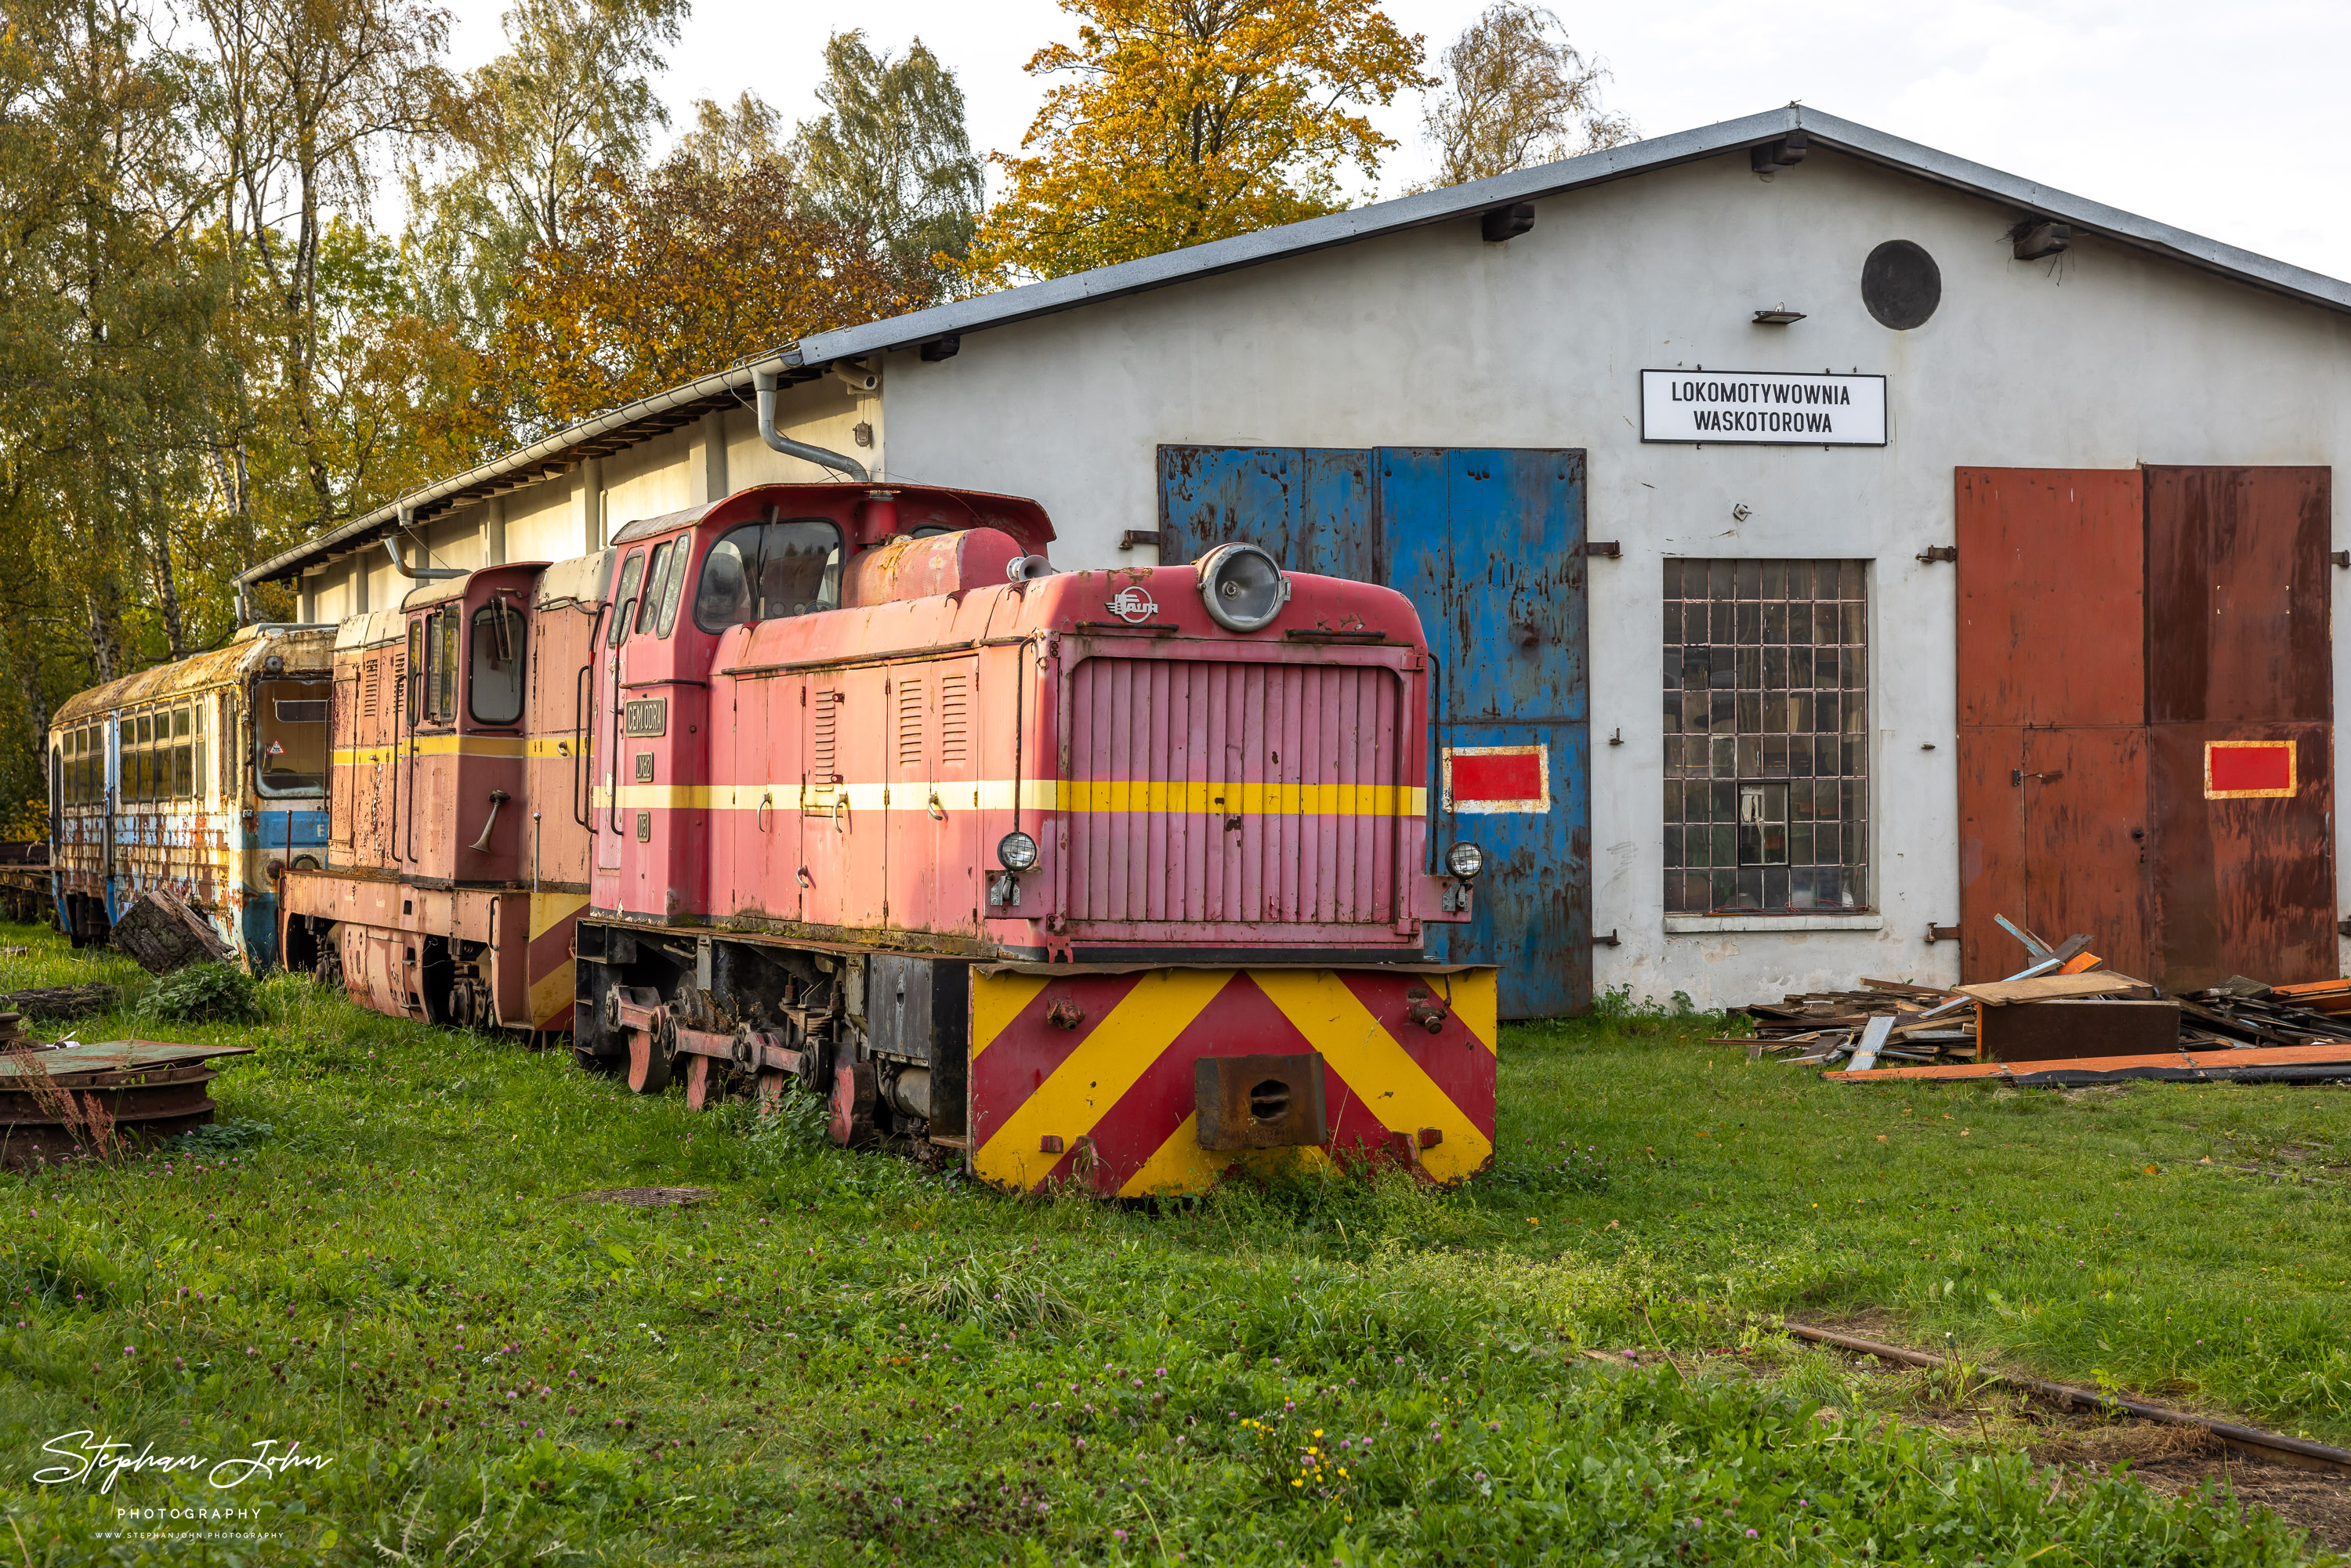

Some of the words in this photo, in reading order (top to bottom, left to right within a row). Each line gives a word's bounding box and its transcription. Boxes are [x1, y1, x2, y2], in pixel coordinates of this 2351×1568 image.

[1672, 382, 1850, 404] LOKOMOTYWOWNIA
[1694, 411, 1832, 433] WĄSKOTOROWA
[639, 816, 647, 837] 05
